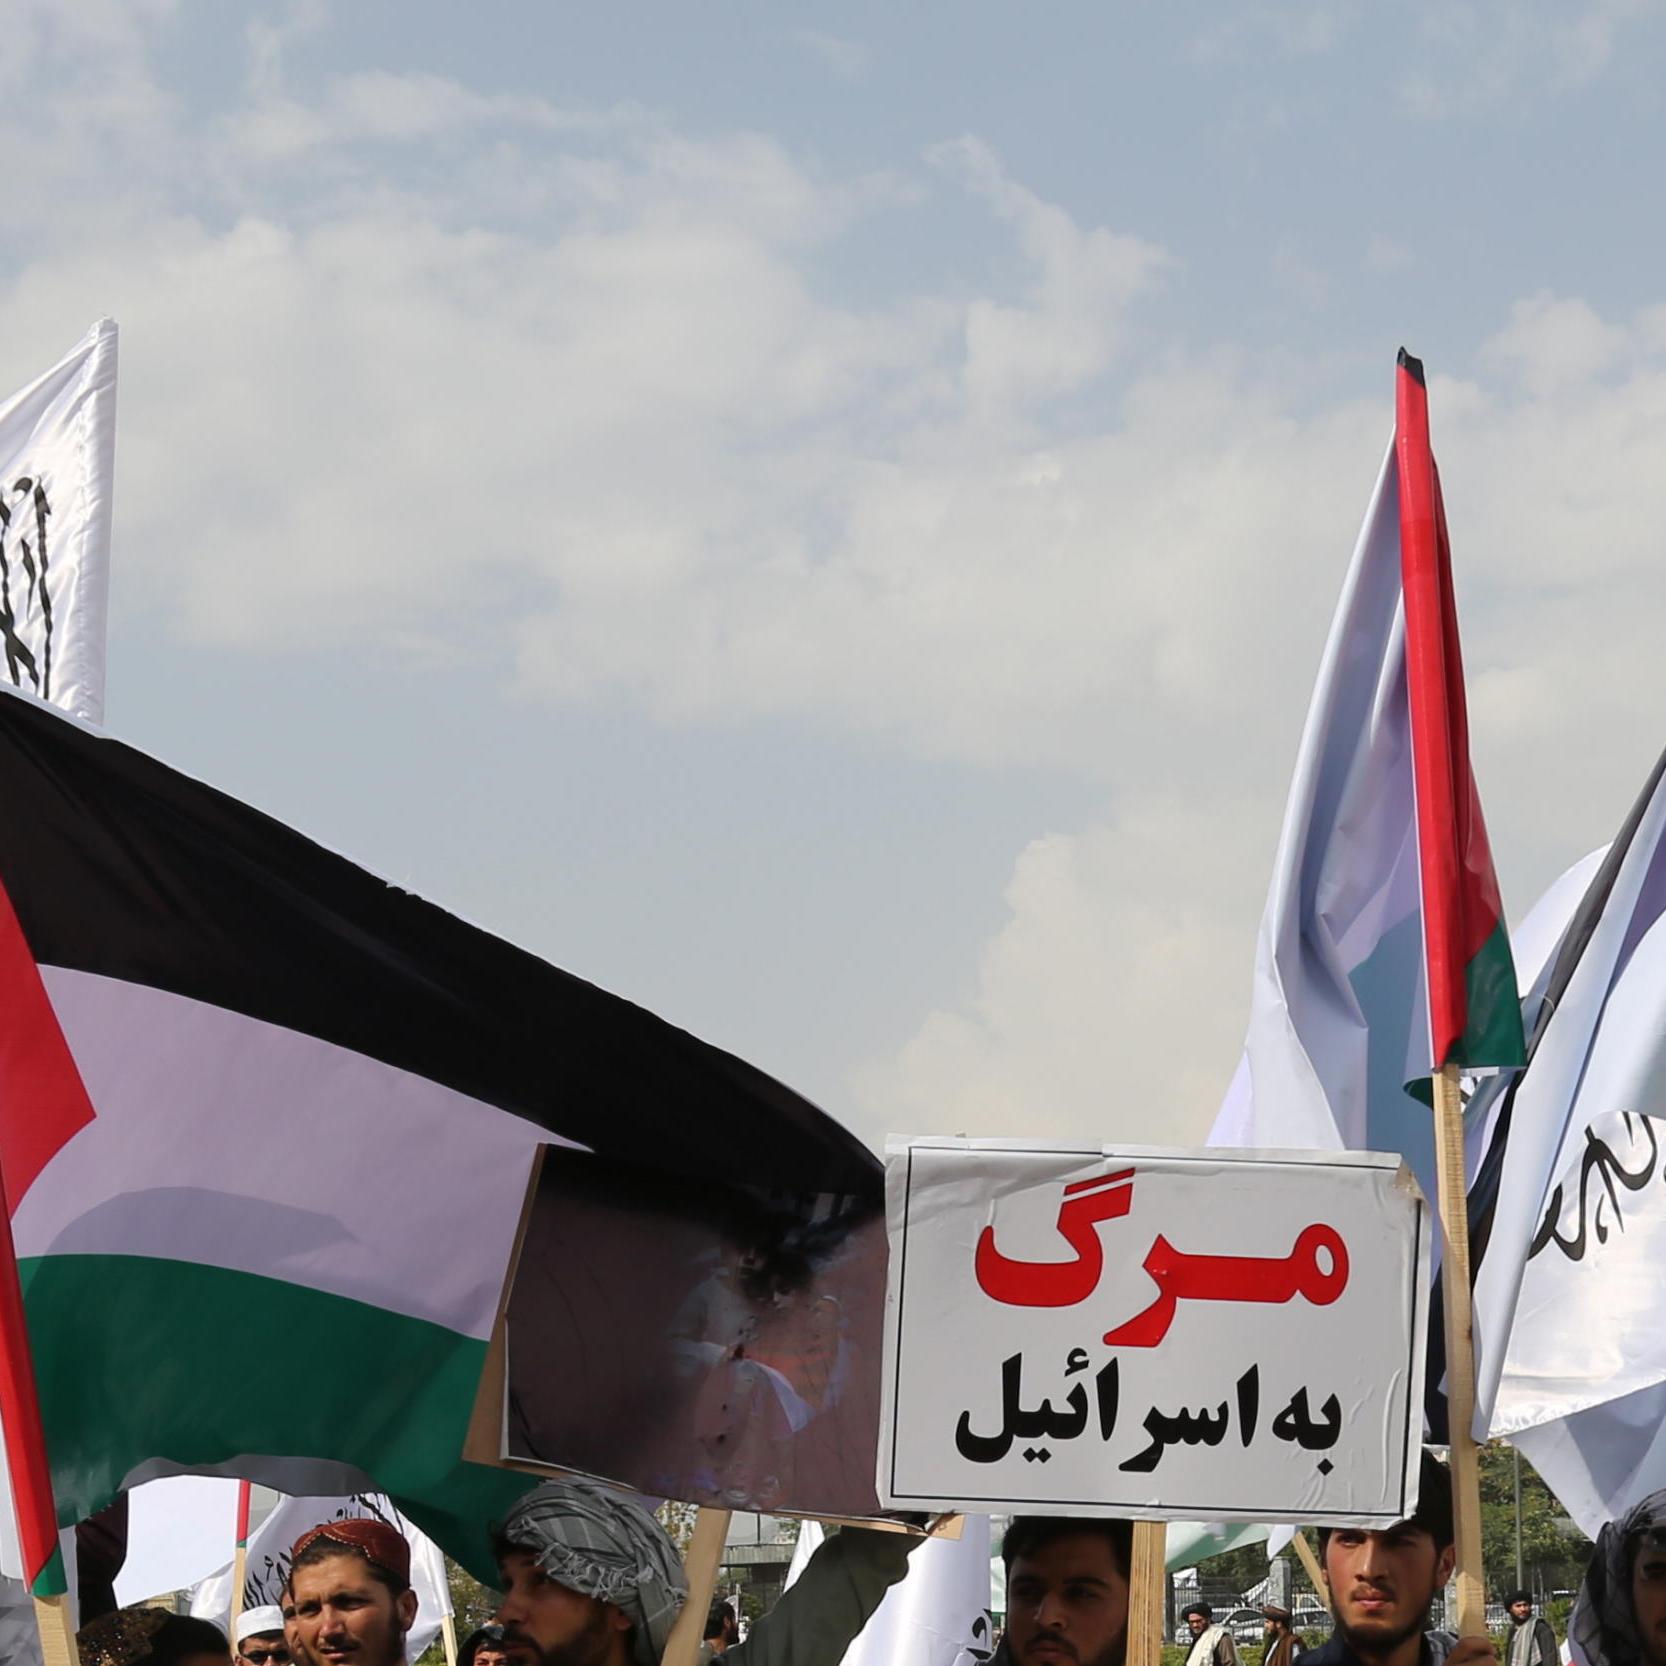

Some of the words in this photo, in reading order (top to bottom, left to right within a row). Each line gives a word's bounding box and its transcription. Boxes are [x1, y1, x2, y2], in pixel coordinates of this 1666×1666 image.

[975, 1168, 1349, 1348] مرگ
[955, 1348, 1259, 1474] اسرائیل
[1272, 1386, 1341, 1476] به
